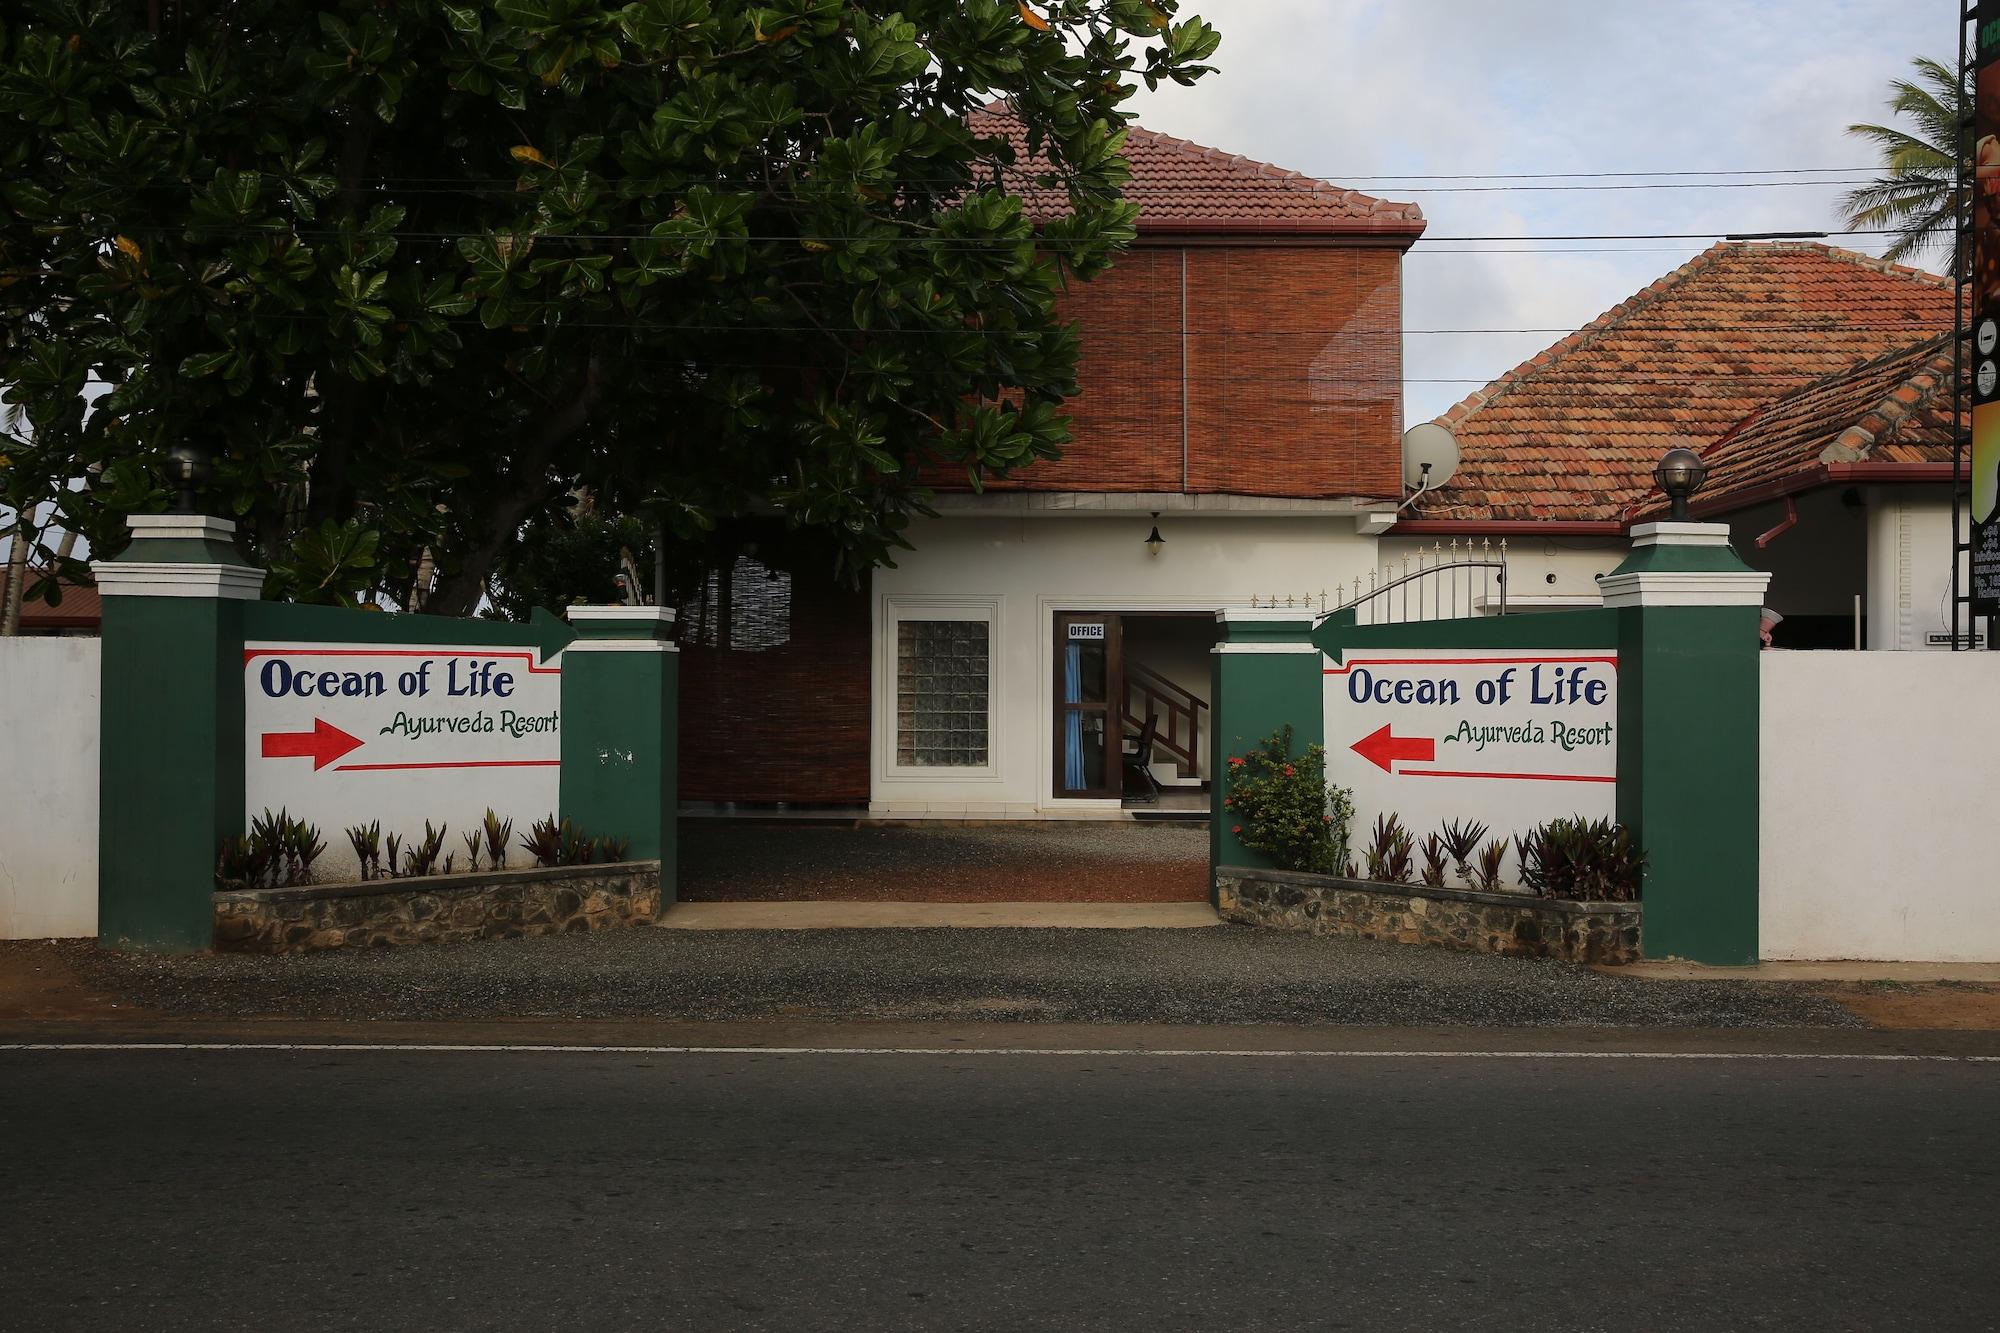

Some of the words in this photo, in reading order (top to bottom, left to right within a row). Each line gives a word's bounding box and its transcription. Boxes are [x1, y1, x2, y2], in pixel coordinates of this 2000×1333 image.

[1070, 626, 1102, 636] OFFICE
[260, 658, 387, 698] Ocean
[398, 660, 433, 698] of
[447, 658, 515, 698] Life
[1348, 668, 1460, 706] Ocean
[1475, 667, 1516, 706] of
[1530, 663, 1608, 706] Life
[379, 710, 495, 740] Ayurveda
[500, 709, 559, 739] Resort
[1443, 719, 1545, 752] Ayurveda
[1550, 720, 1613, 752] Resort
